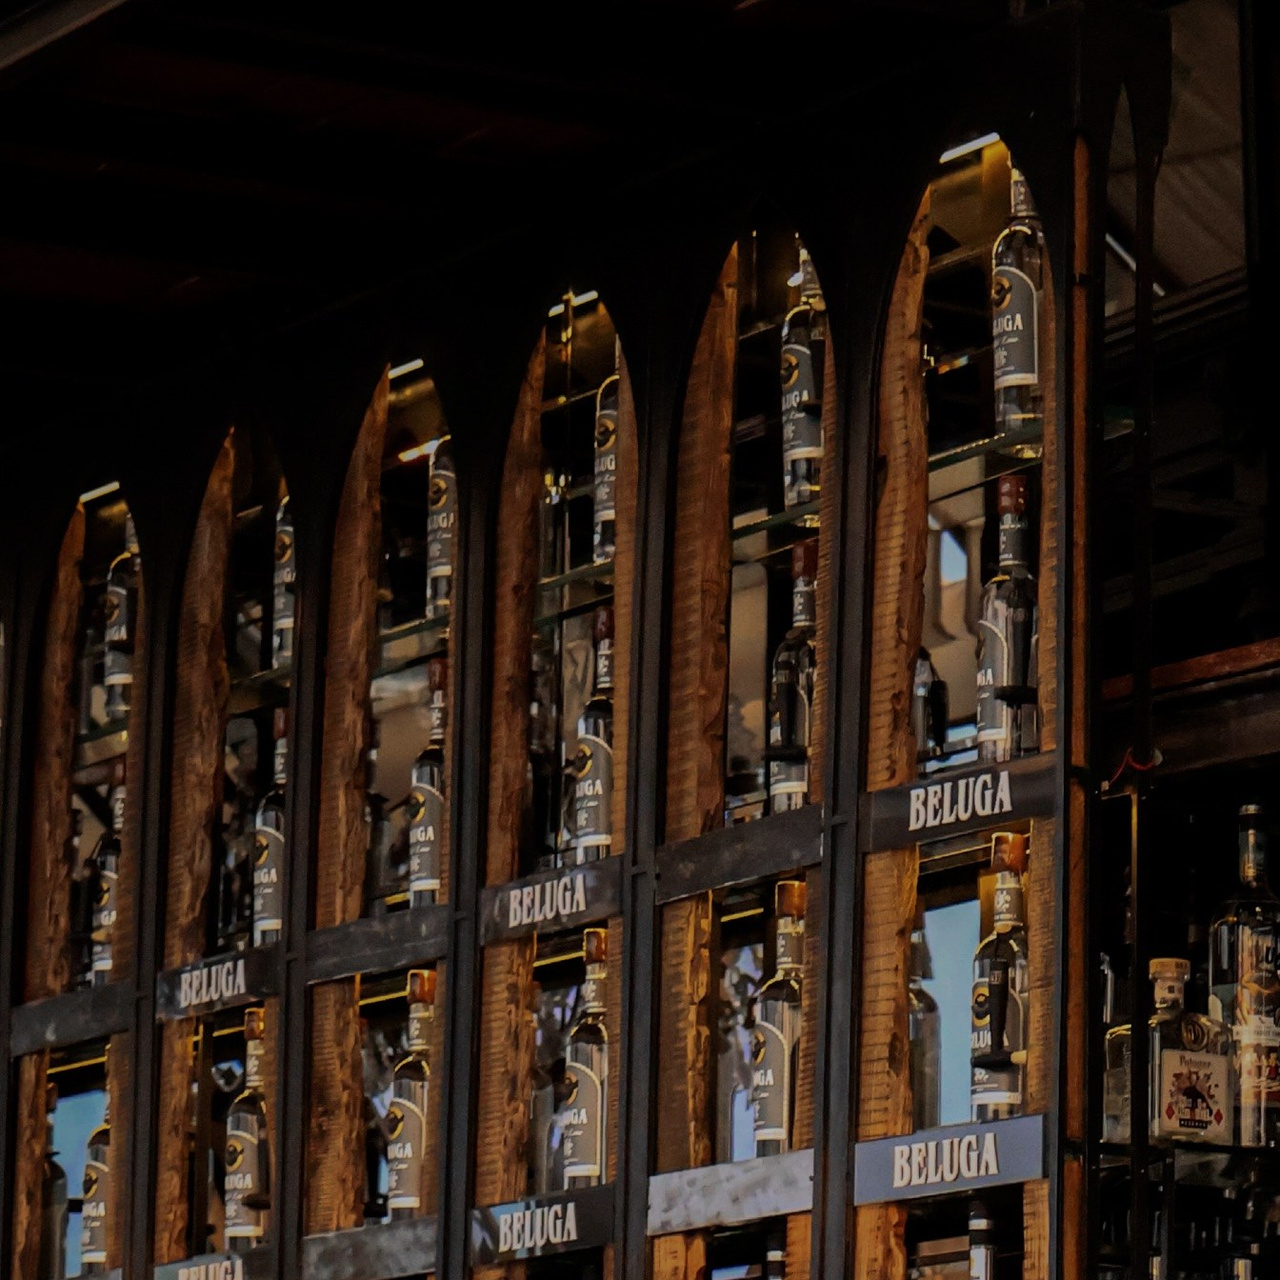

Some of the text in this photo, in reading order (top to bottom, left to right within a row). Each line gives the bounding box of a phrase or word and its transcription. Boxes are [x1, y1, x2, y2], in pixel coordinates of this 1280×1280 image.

[908, 770, 1013, 831] BELUGA
[509, 873, 586, 928] BELUGA
[180, 958, 247, 1008] BELUGA
[893, 1132, 999, 1188] BELUGA
[499, 1201, 578, 1253] BELUGA
